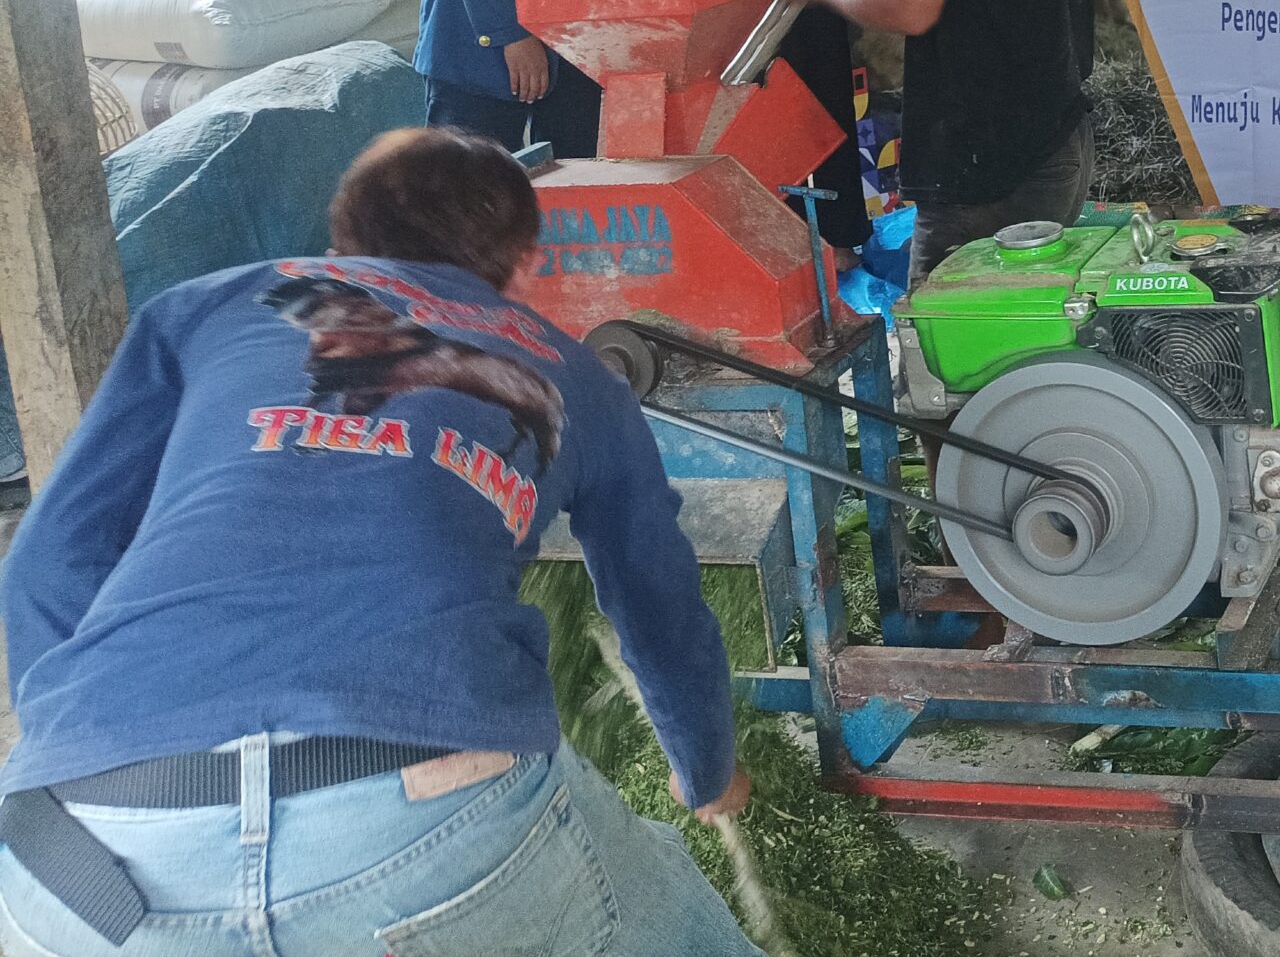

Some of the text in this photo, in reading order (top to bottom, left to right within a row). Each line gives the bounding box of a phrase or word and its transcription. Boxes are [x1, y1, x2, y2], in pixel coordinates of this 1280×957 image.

[1191, 94, 1260, 132] Menuju
[602, 204, 673, 243] JAYA
[1115, 276, 1190, 291] KUBOTA
[247, 406, 413, 457] TIGA
